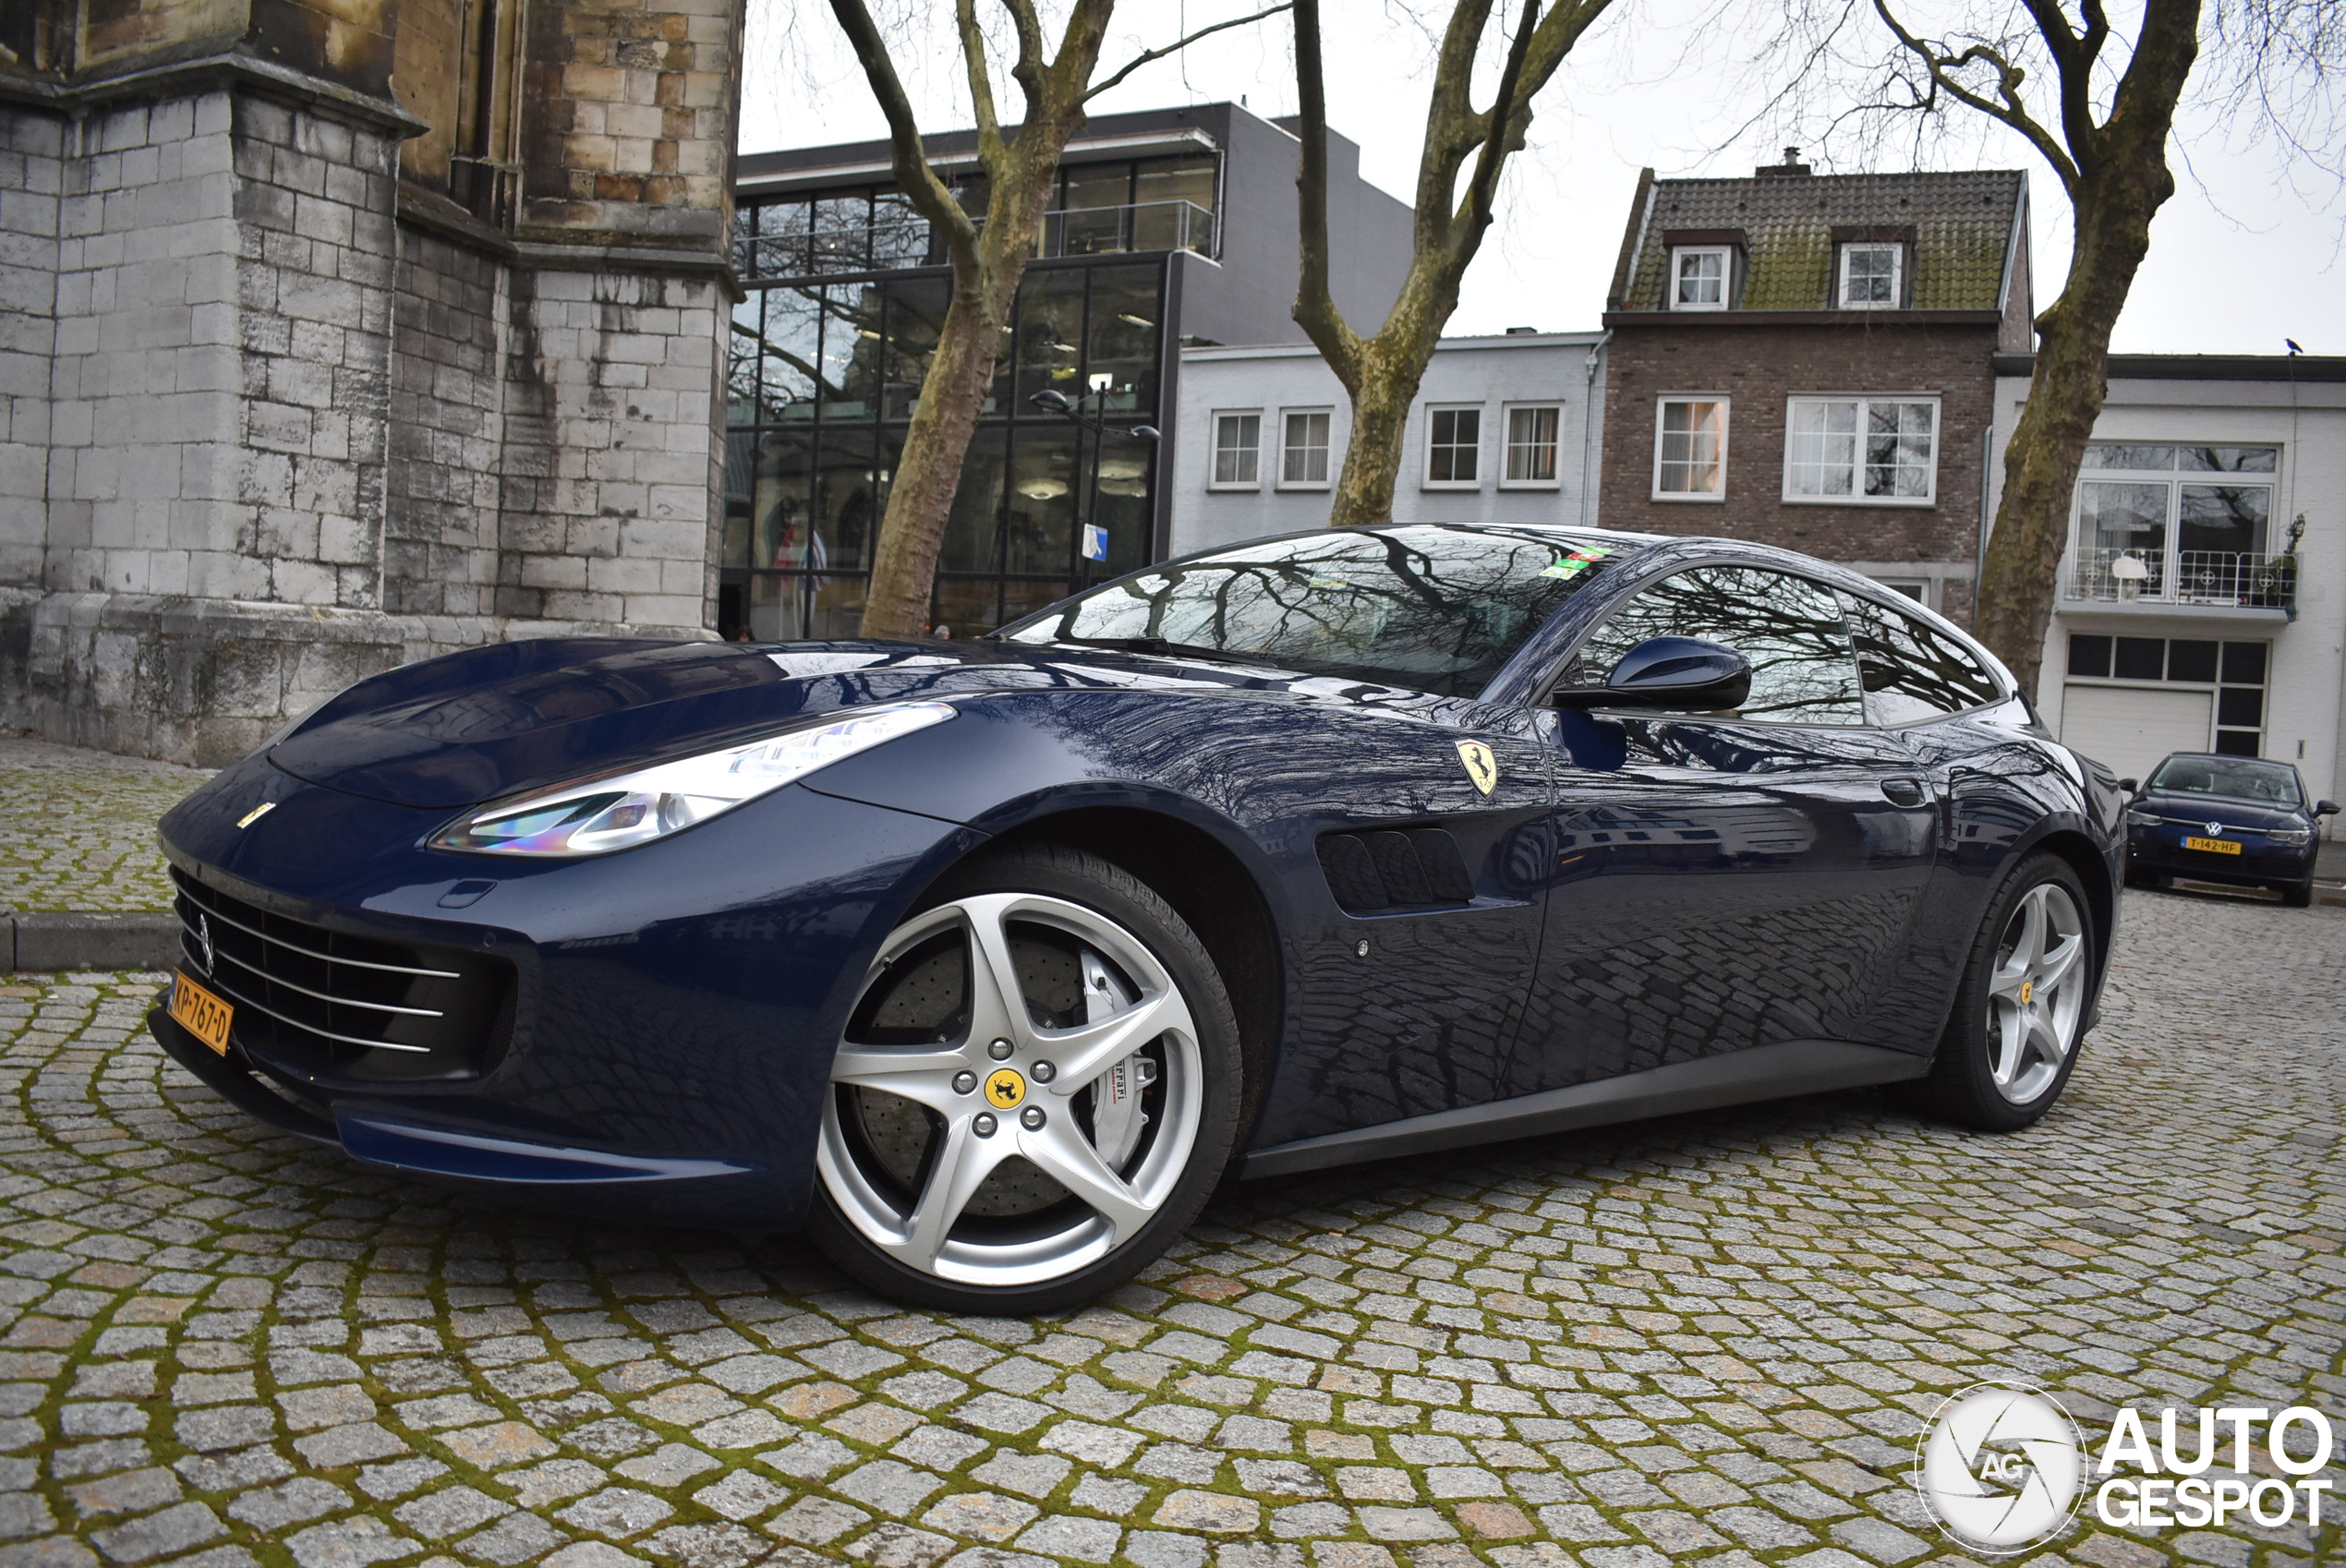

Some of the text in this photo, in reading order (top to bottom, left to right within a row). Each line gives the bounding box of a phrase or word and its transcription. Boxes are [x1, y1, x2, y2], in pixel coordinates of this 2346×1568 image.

[2191, 839, 2235, 851] T-142-HF
[175, 980, 226, 1043] KP-767-D
[1116, 1059, 1127, 1100] errari
